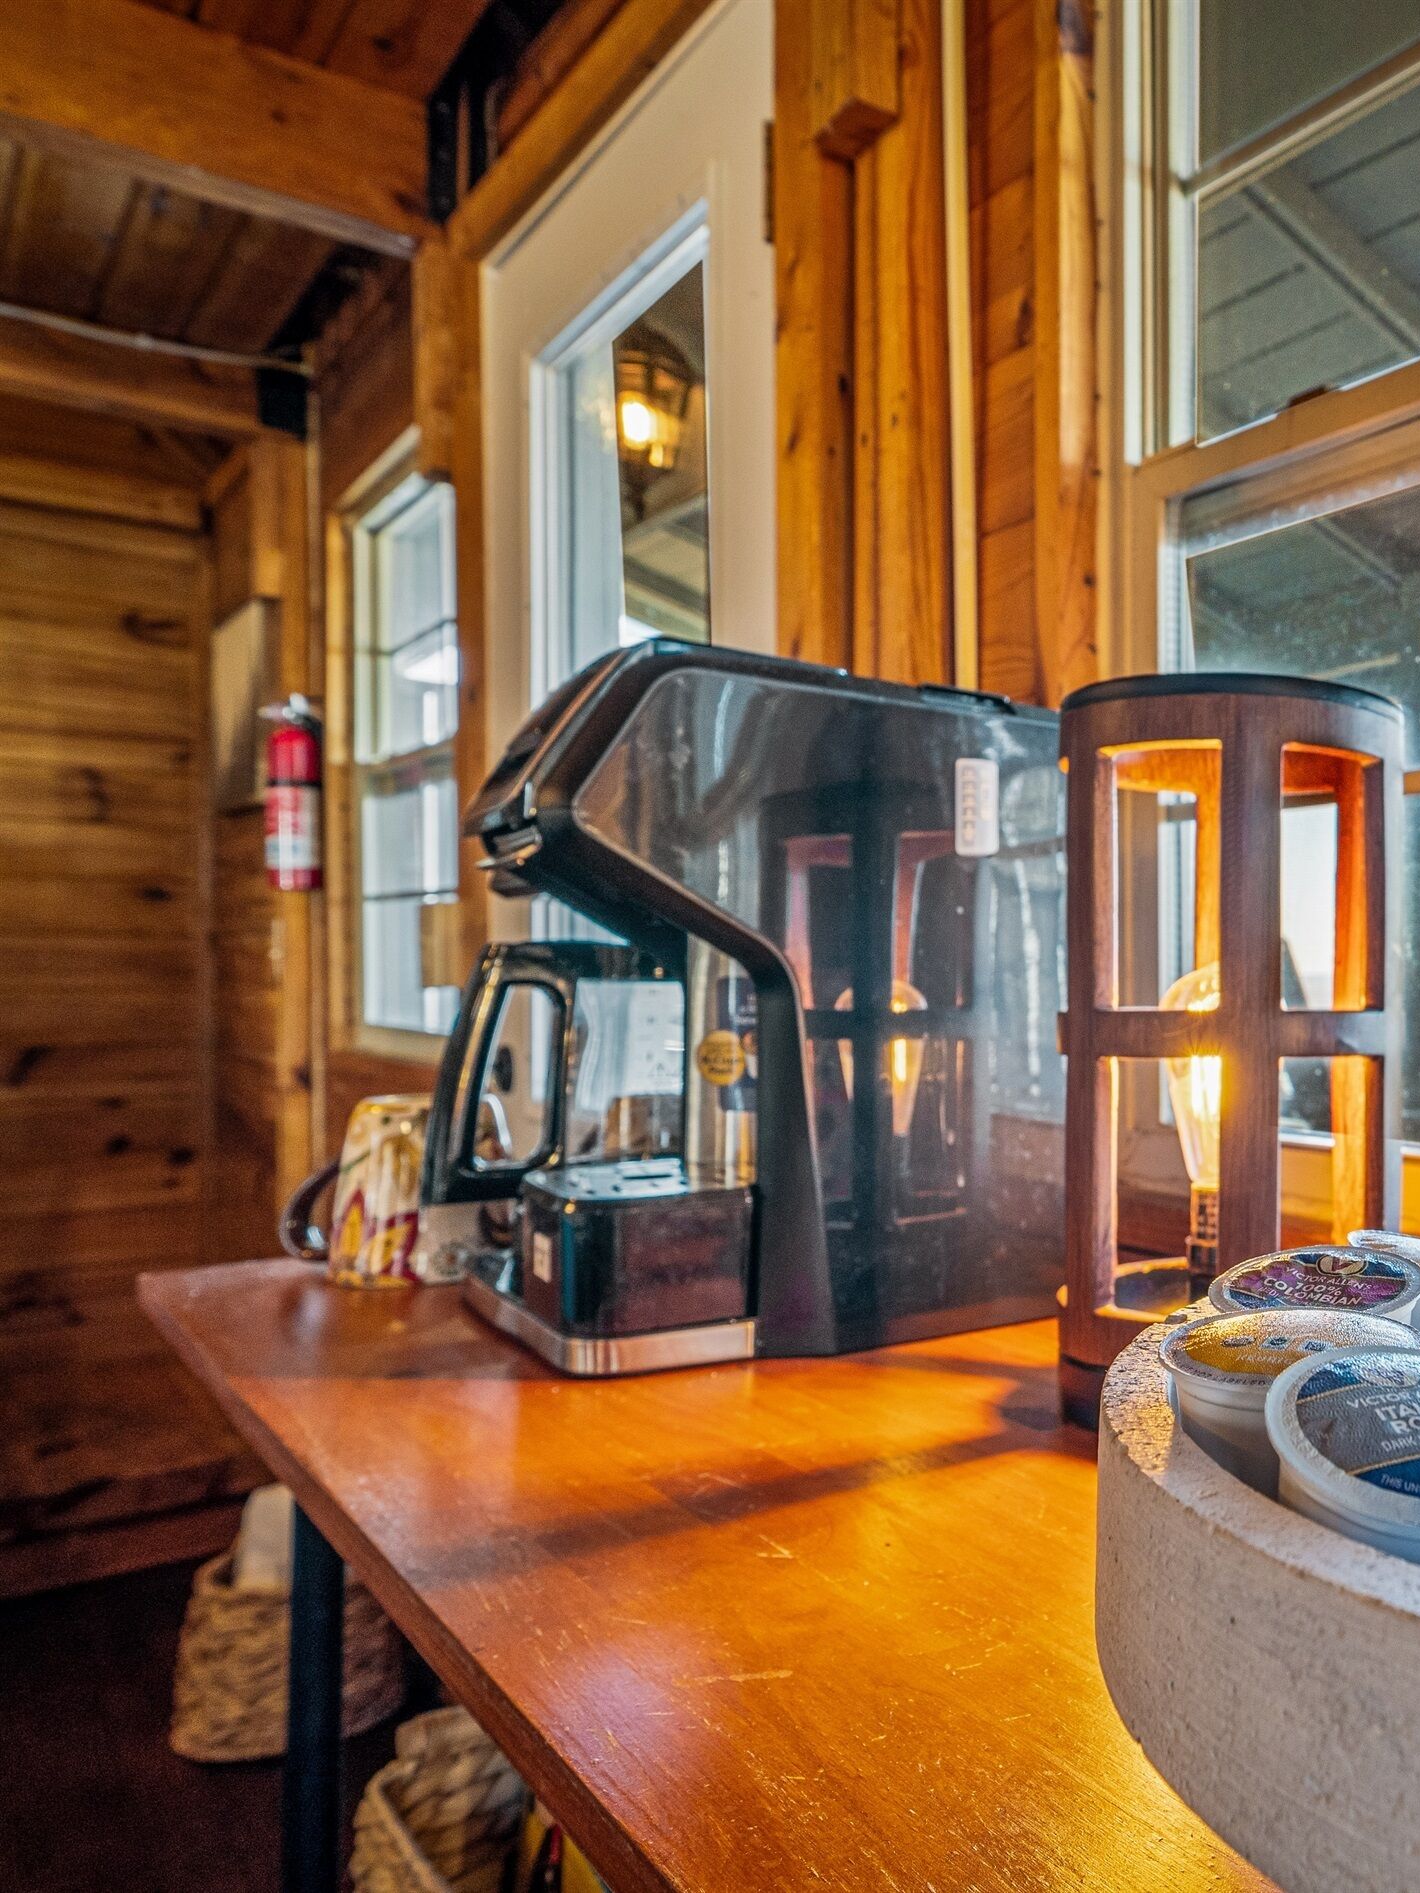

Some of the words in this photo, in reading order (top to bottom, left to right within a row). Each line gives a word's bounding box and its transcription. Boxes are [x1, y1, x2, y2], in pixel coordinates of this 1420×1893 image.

[1286, 1266, 1325, 1283] VICTOR
[1263, 1276, 1361, 1305] COLOMBIAN
[1295, 1281, 1341, 1296] 100%
[1347, 1390, 1410, 1409] VICTOR
[1380, 1434, 1417, 1452] DARK
[1380, 1474, 1404, 1490] THIS
